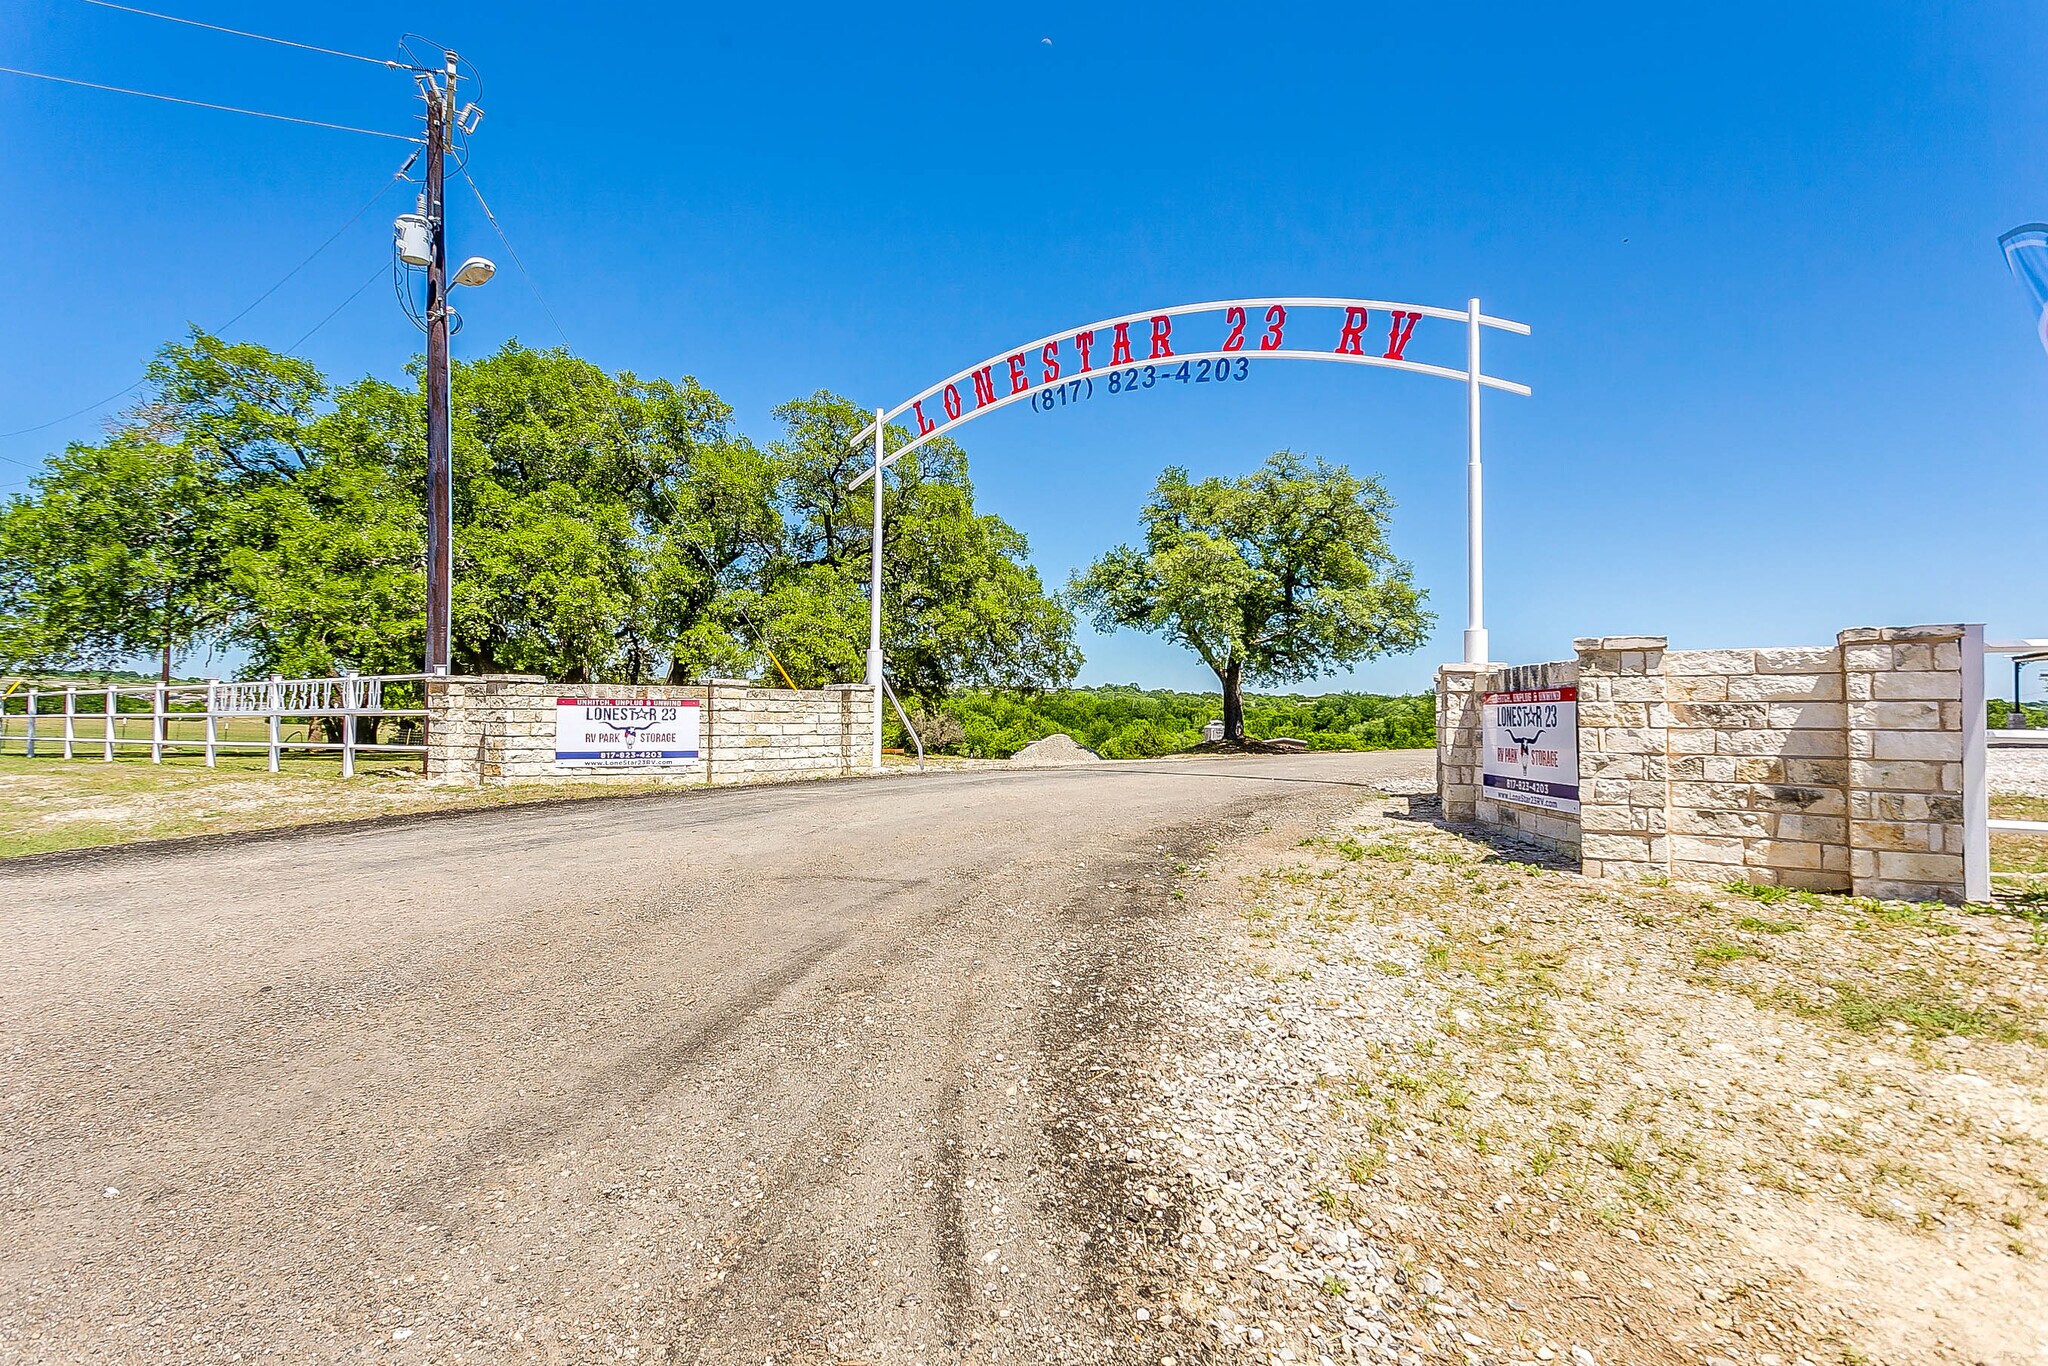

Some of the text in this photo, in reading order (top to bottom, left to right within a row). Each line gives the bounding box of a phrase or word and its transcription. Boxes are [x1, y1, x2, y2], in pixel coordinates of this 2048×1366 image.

[912, 304, 1422, 438] LONESTAR 23 RV
[1030, 357, 1250, 414] (817) 823-4203
[661, 707, 677, 721] 23
[1545, 705, 1557, 727] 23
[585, 733, 676, 743] RV PARK STORAGE
[600, 751, 662, 759] 817-823-4203
[1497, 747, 1559, 768] RV PARK STORAGE
[1506, 779, 1549, 794] 817-823-4203
